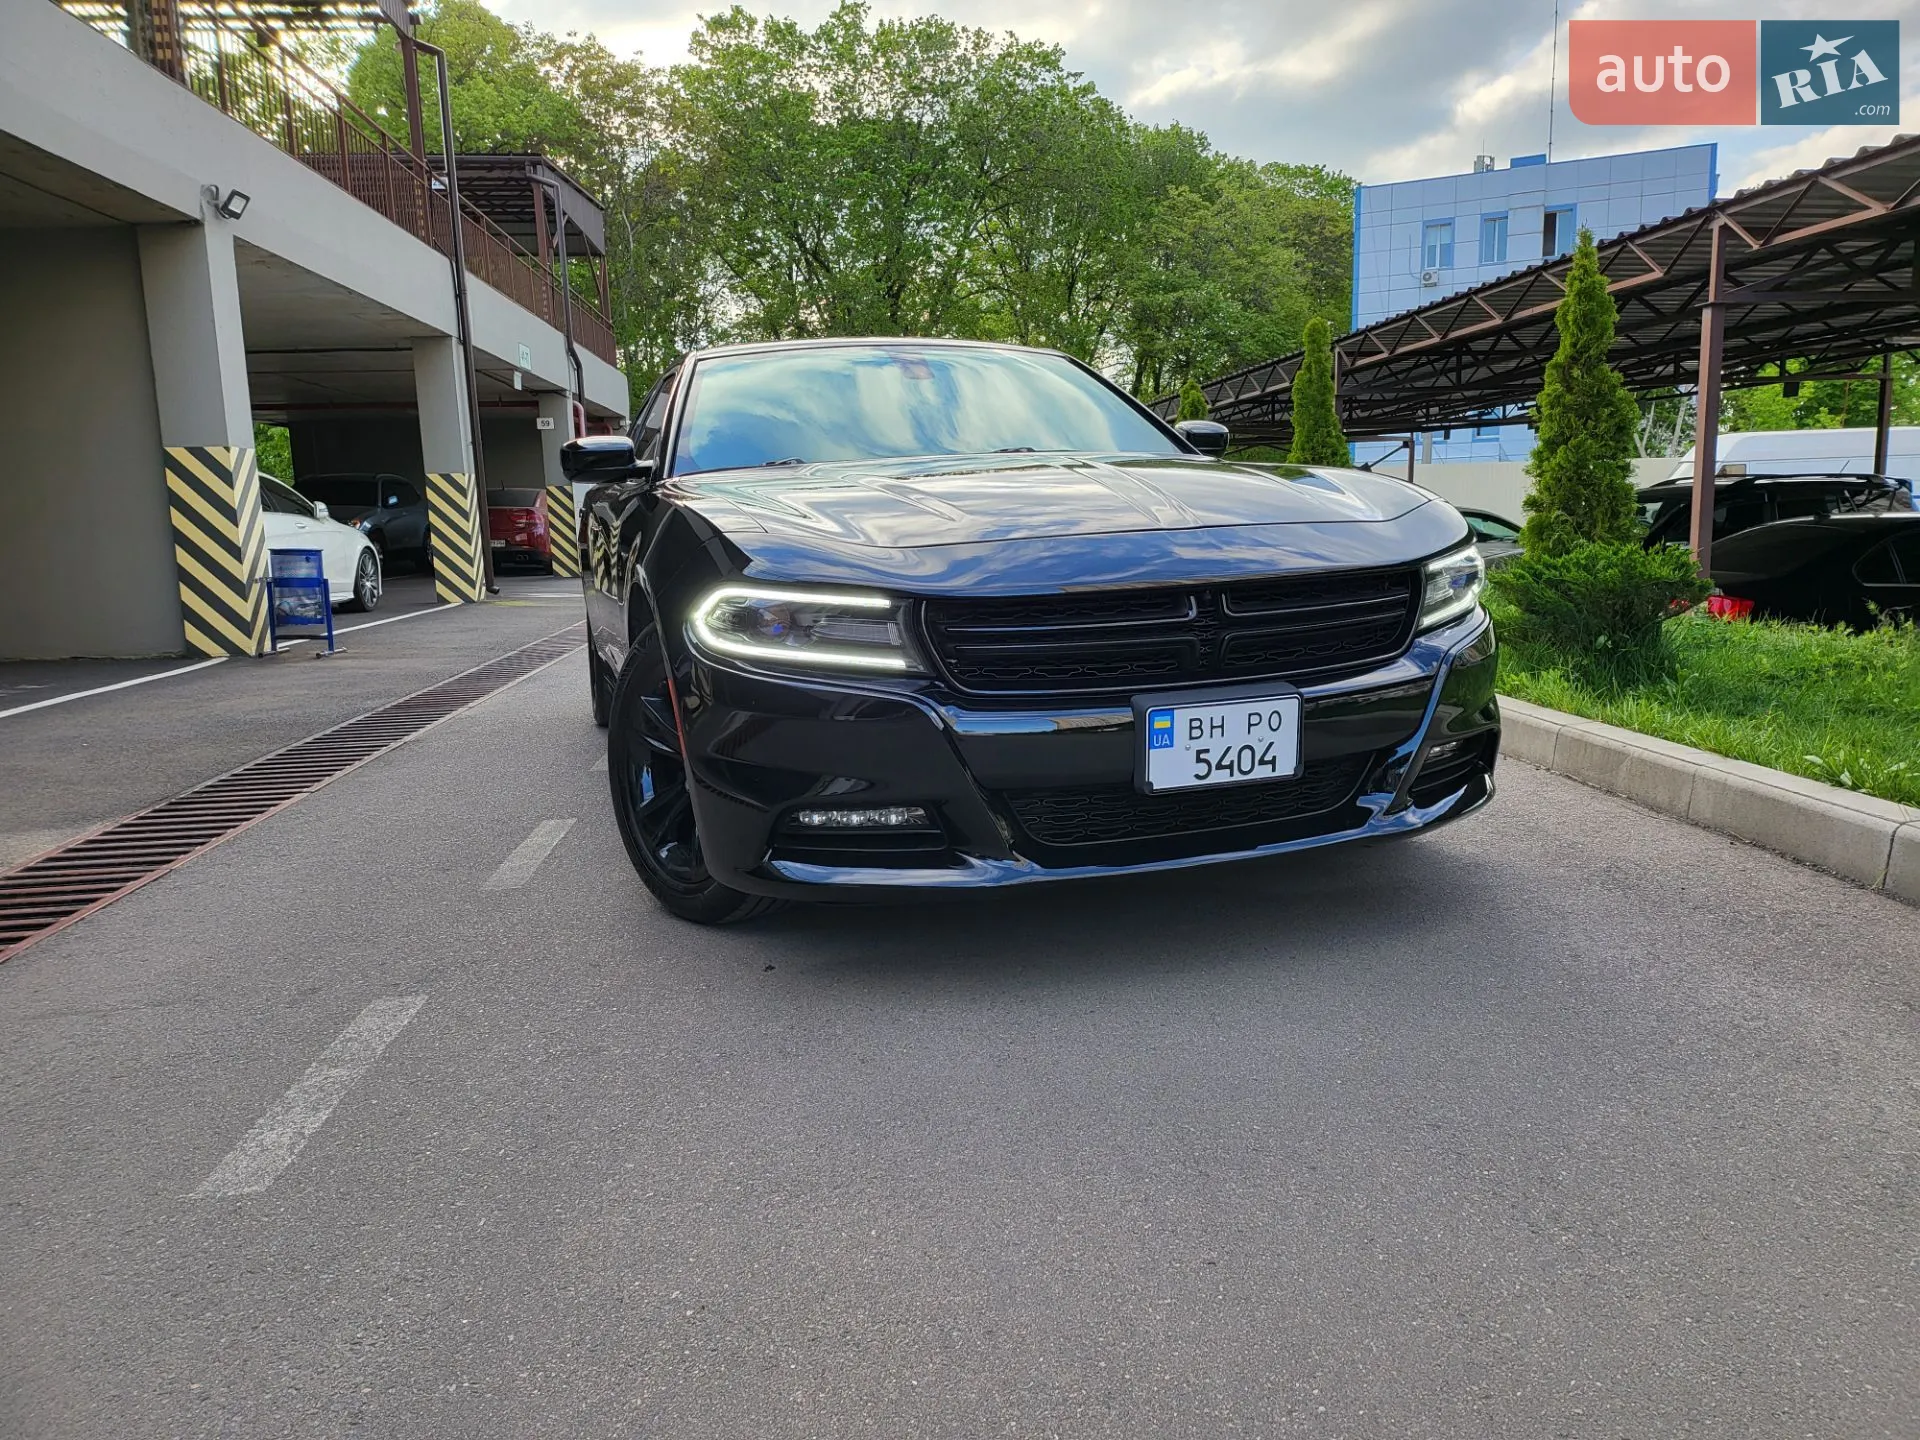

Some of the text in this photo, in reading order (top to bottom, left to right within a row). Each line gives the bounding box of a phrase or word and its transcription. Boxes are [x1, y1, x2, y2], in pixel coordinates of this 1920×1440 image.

[1188, 715, 1225, 740] BH
[1153, 734, 1170, 747] UA
[1193, 741, 1277, 780] 5404
